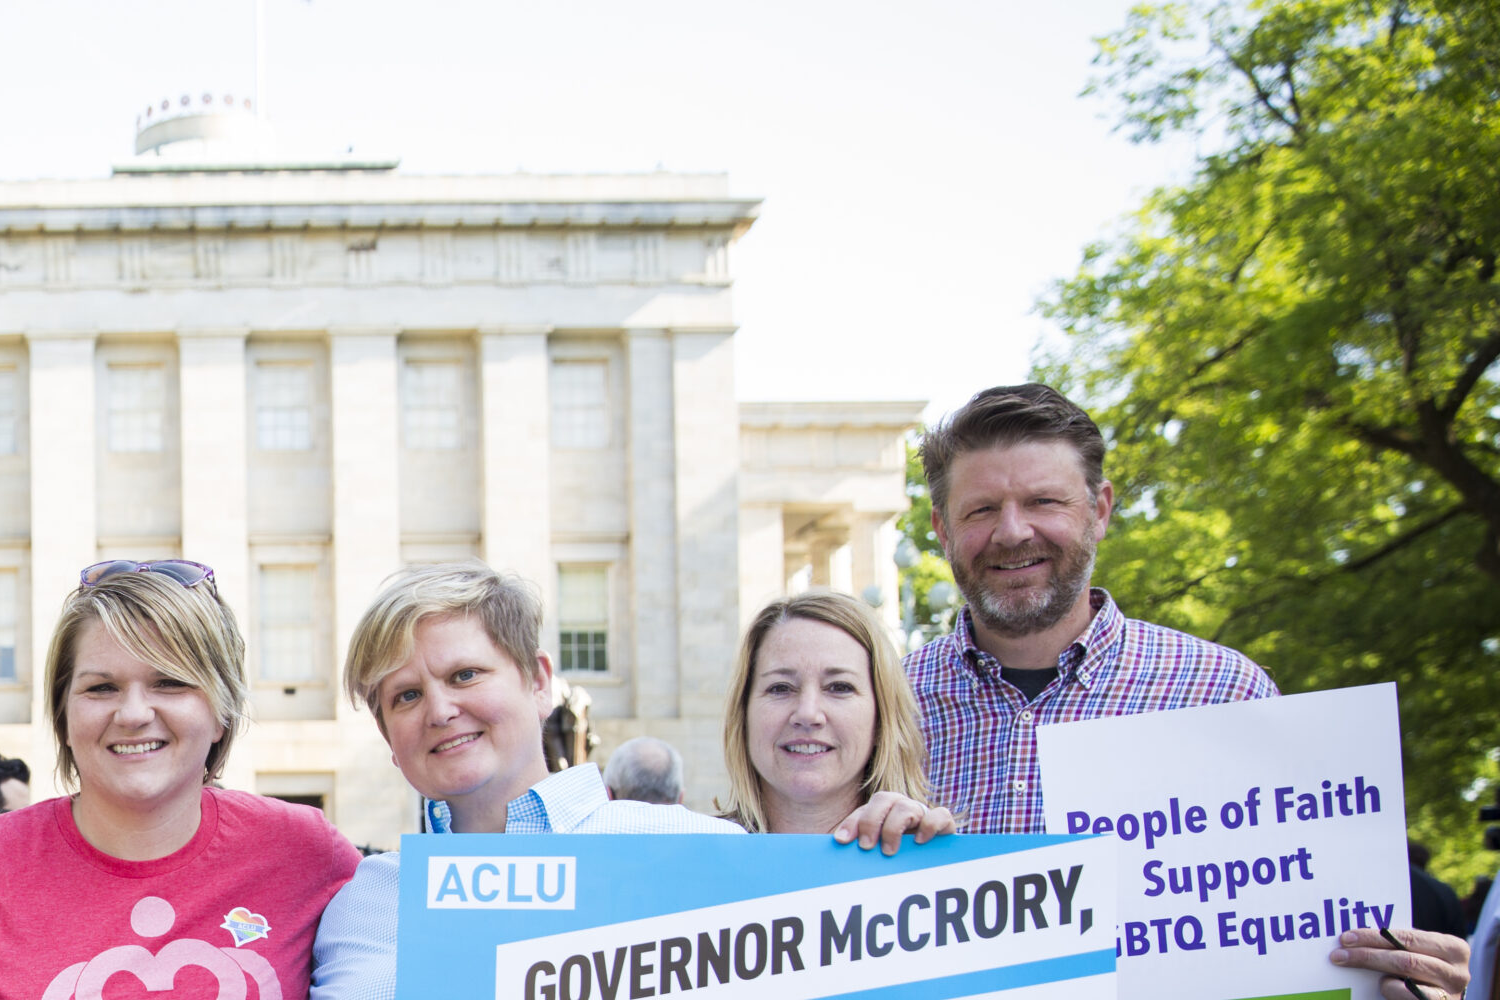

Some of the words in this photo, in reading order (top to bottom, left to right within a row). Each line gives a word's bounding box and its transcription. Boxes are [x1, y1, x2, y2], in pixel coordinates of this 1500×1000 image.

[1067, 797, 1208, 849] People
[1220, 787, 1260, 831] of
[1275, 776, 1381, 824] Faith
[435, 862, 568, 903] ACLU
[1143, 847, 1313, 902] Support
[819, 864, 1094, 967] McCRORY,
[1116, 915, 1206, 958] BTQ
[1218, 898, 1394, 955] Equality
